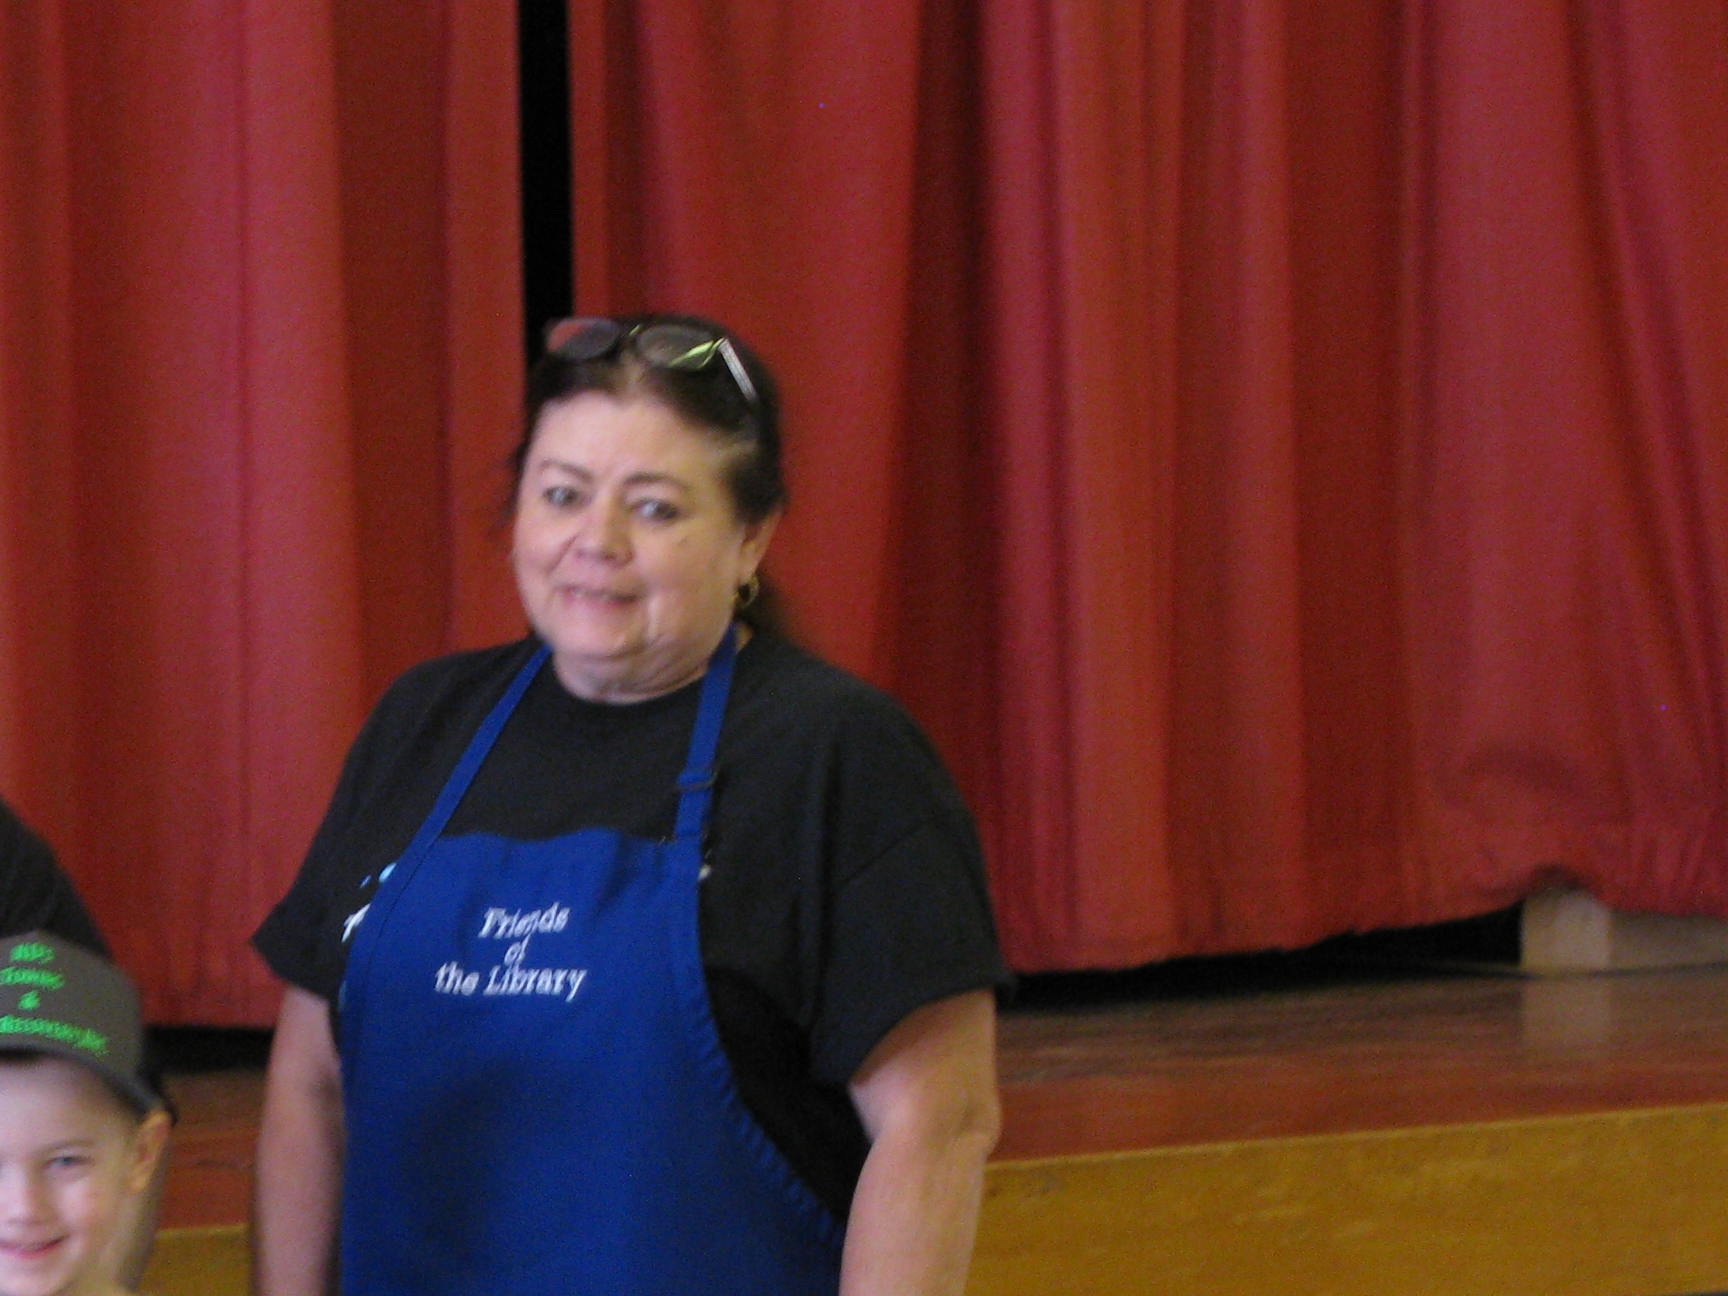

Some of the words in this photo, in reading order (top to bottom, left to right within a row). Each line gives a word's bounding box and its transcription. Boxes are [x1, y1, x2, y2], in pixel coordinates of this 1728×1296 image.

[478, 902, 571, 938] Friends
[503, 933, 532, 966] of
[434, 961, 479, 996] the
[483, 963, 588, 1001] Library
